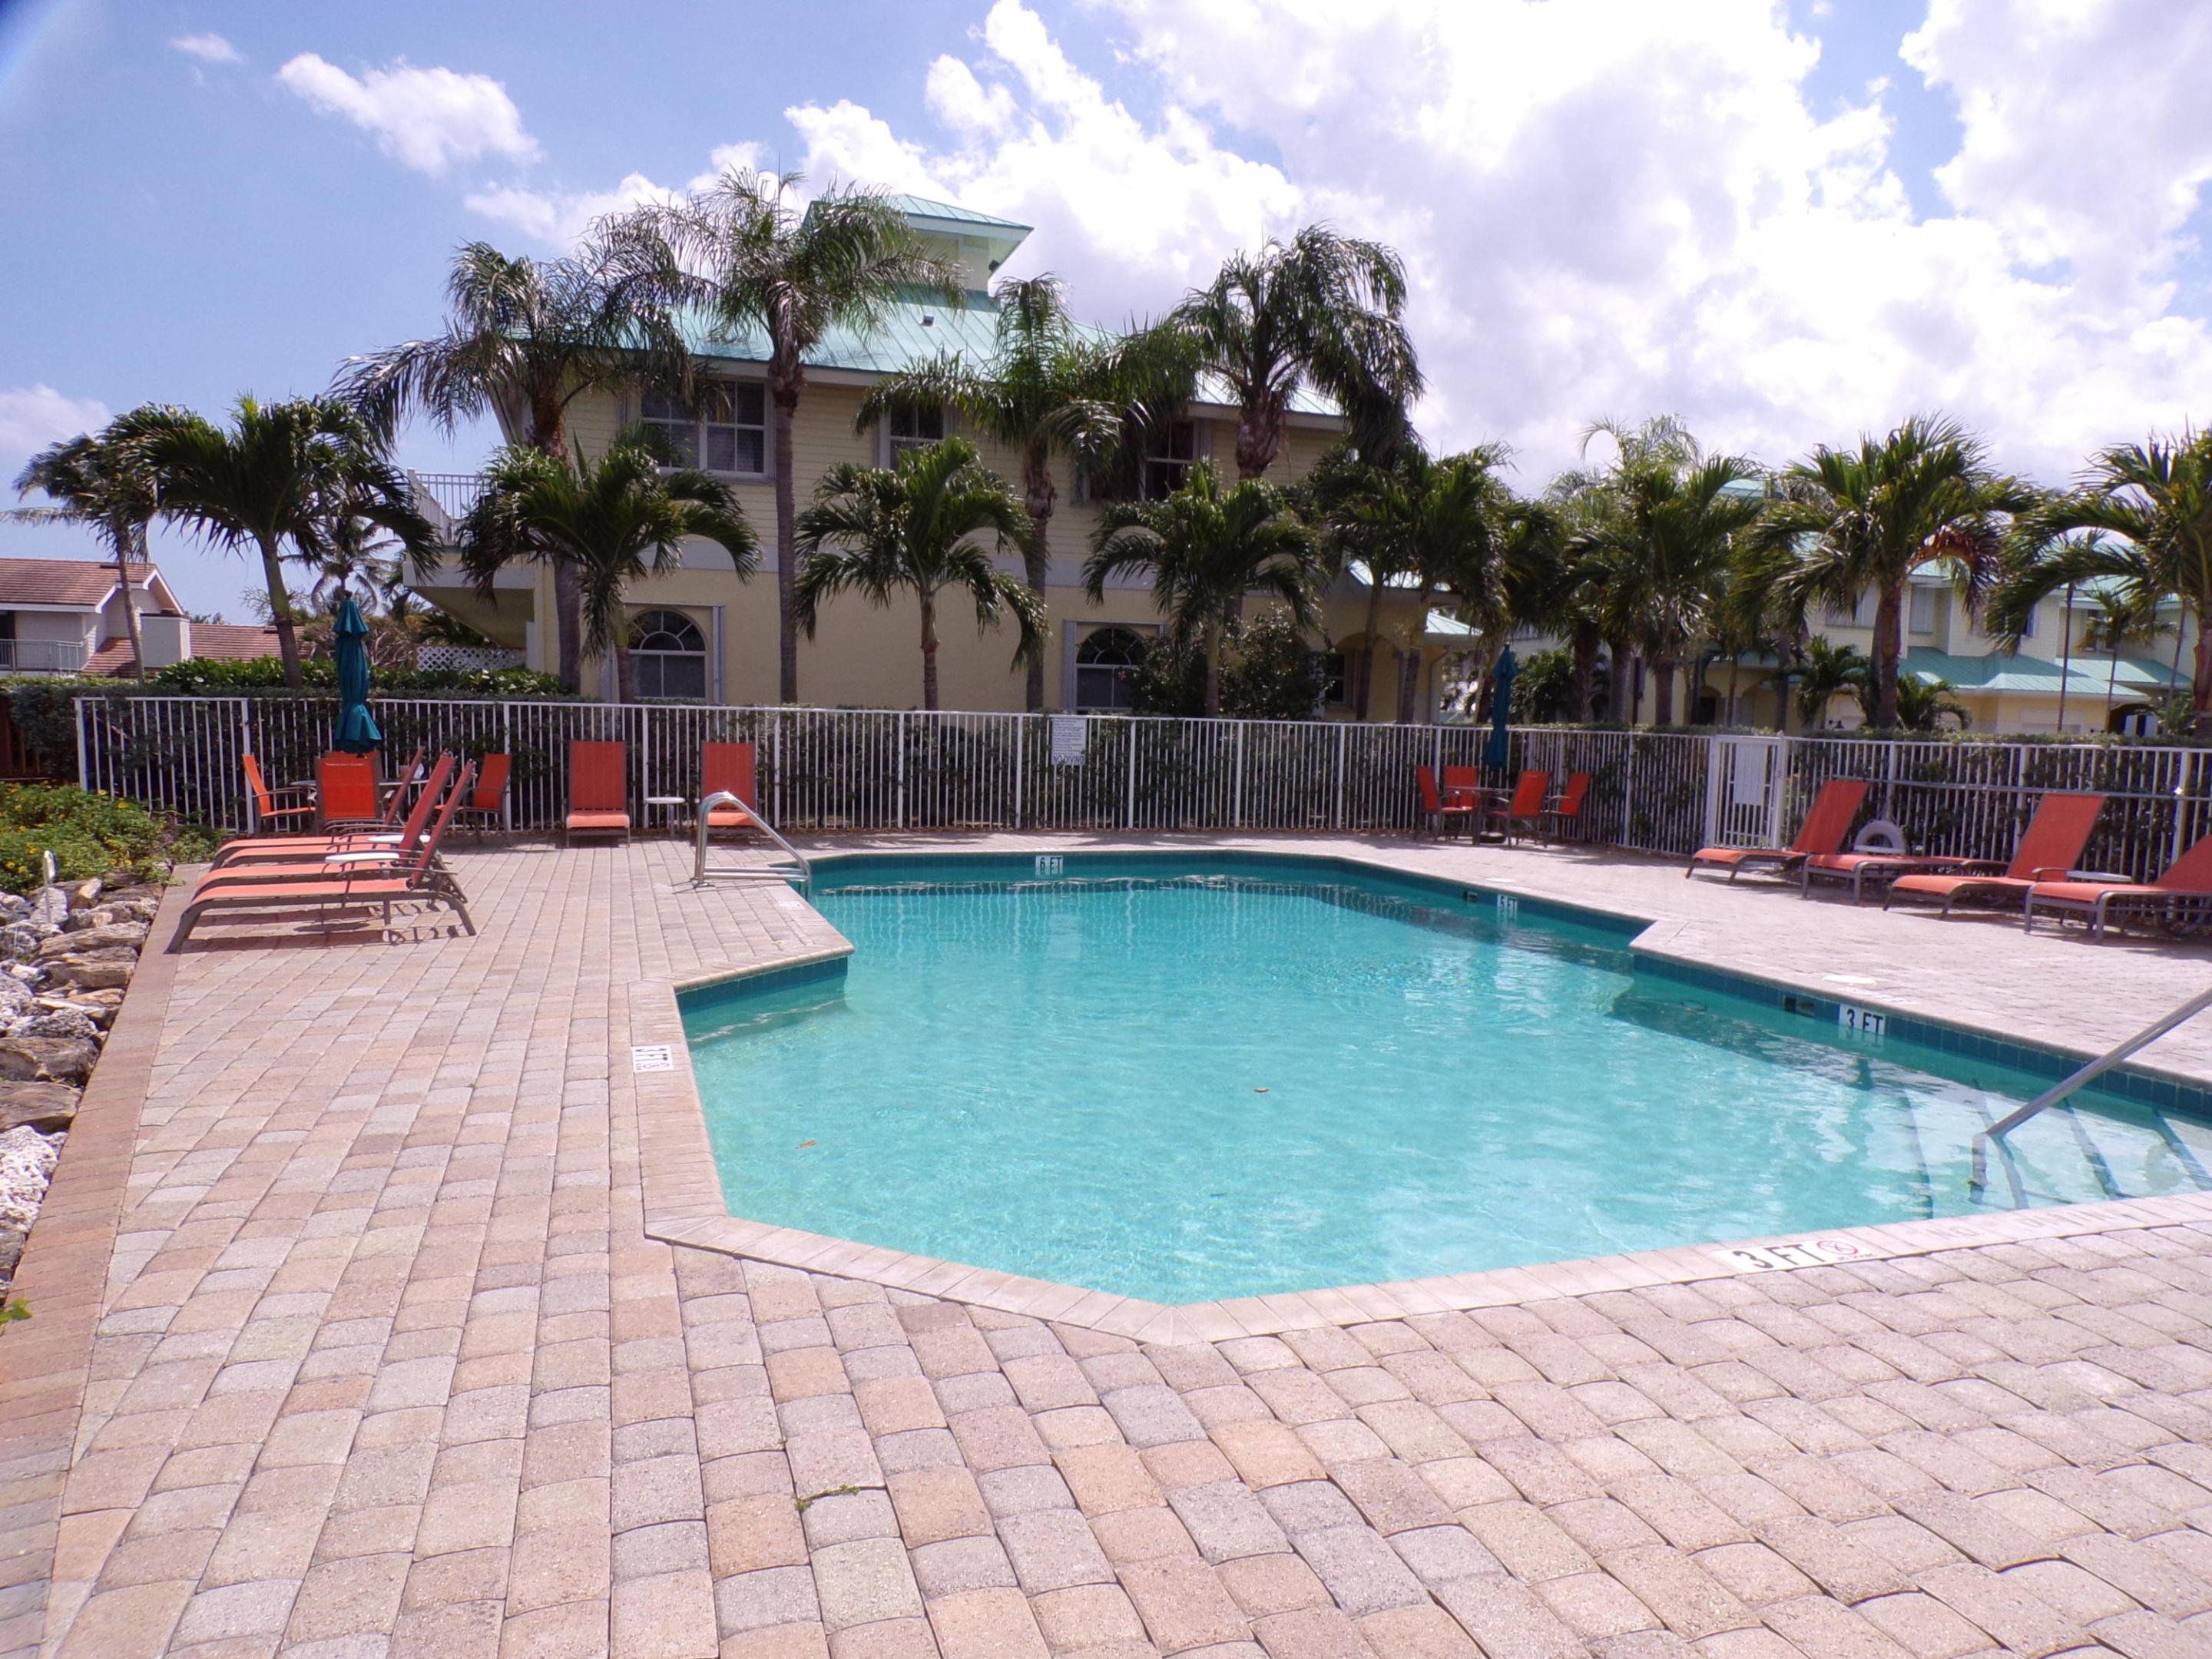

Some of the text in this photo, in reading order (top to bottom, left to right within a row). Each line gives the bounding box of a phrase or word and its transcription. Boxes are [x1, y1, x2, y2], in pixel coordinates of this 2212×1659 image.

[1050, 856, 1061, 869] FT
[1846, 1008, 1883, 1033] 3 FT
[1732, 1250, 1774, 1268] 3
[1763, 1244, 1826, 1266] FT
